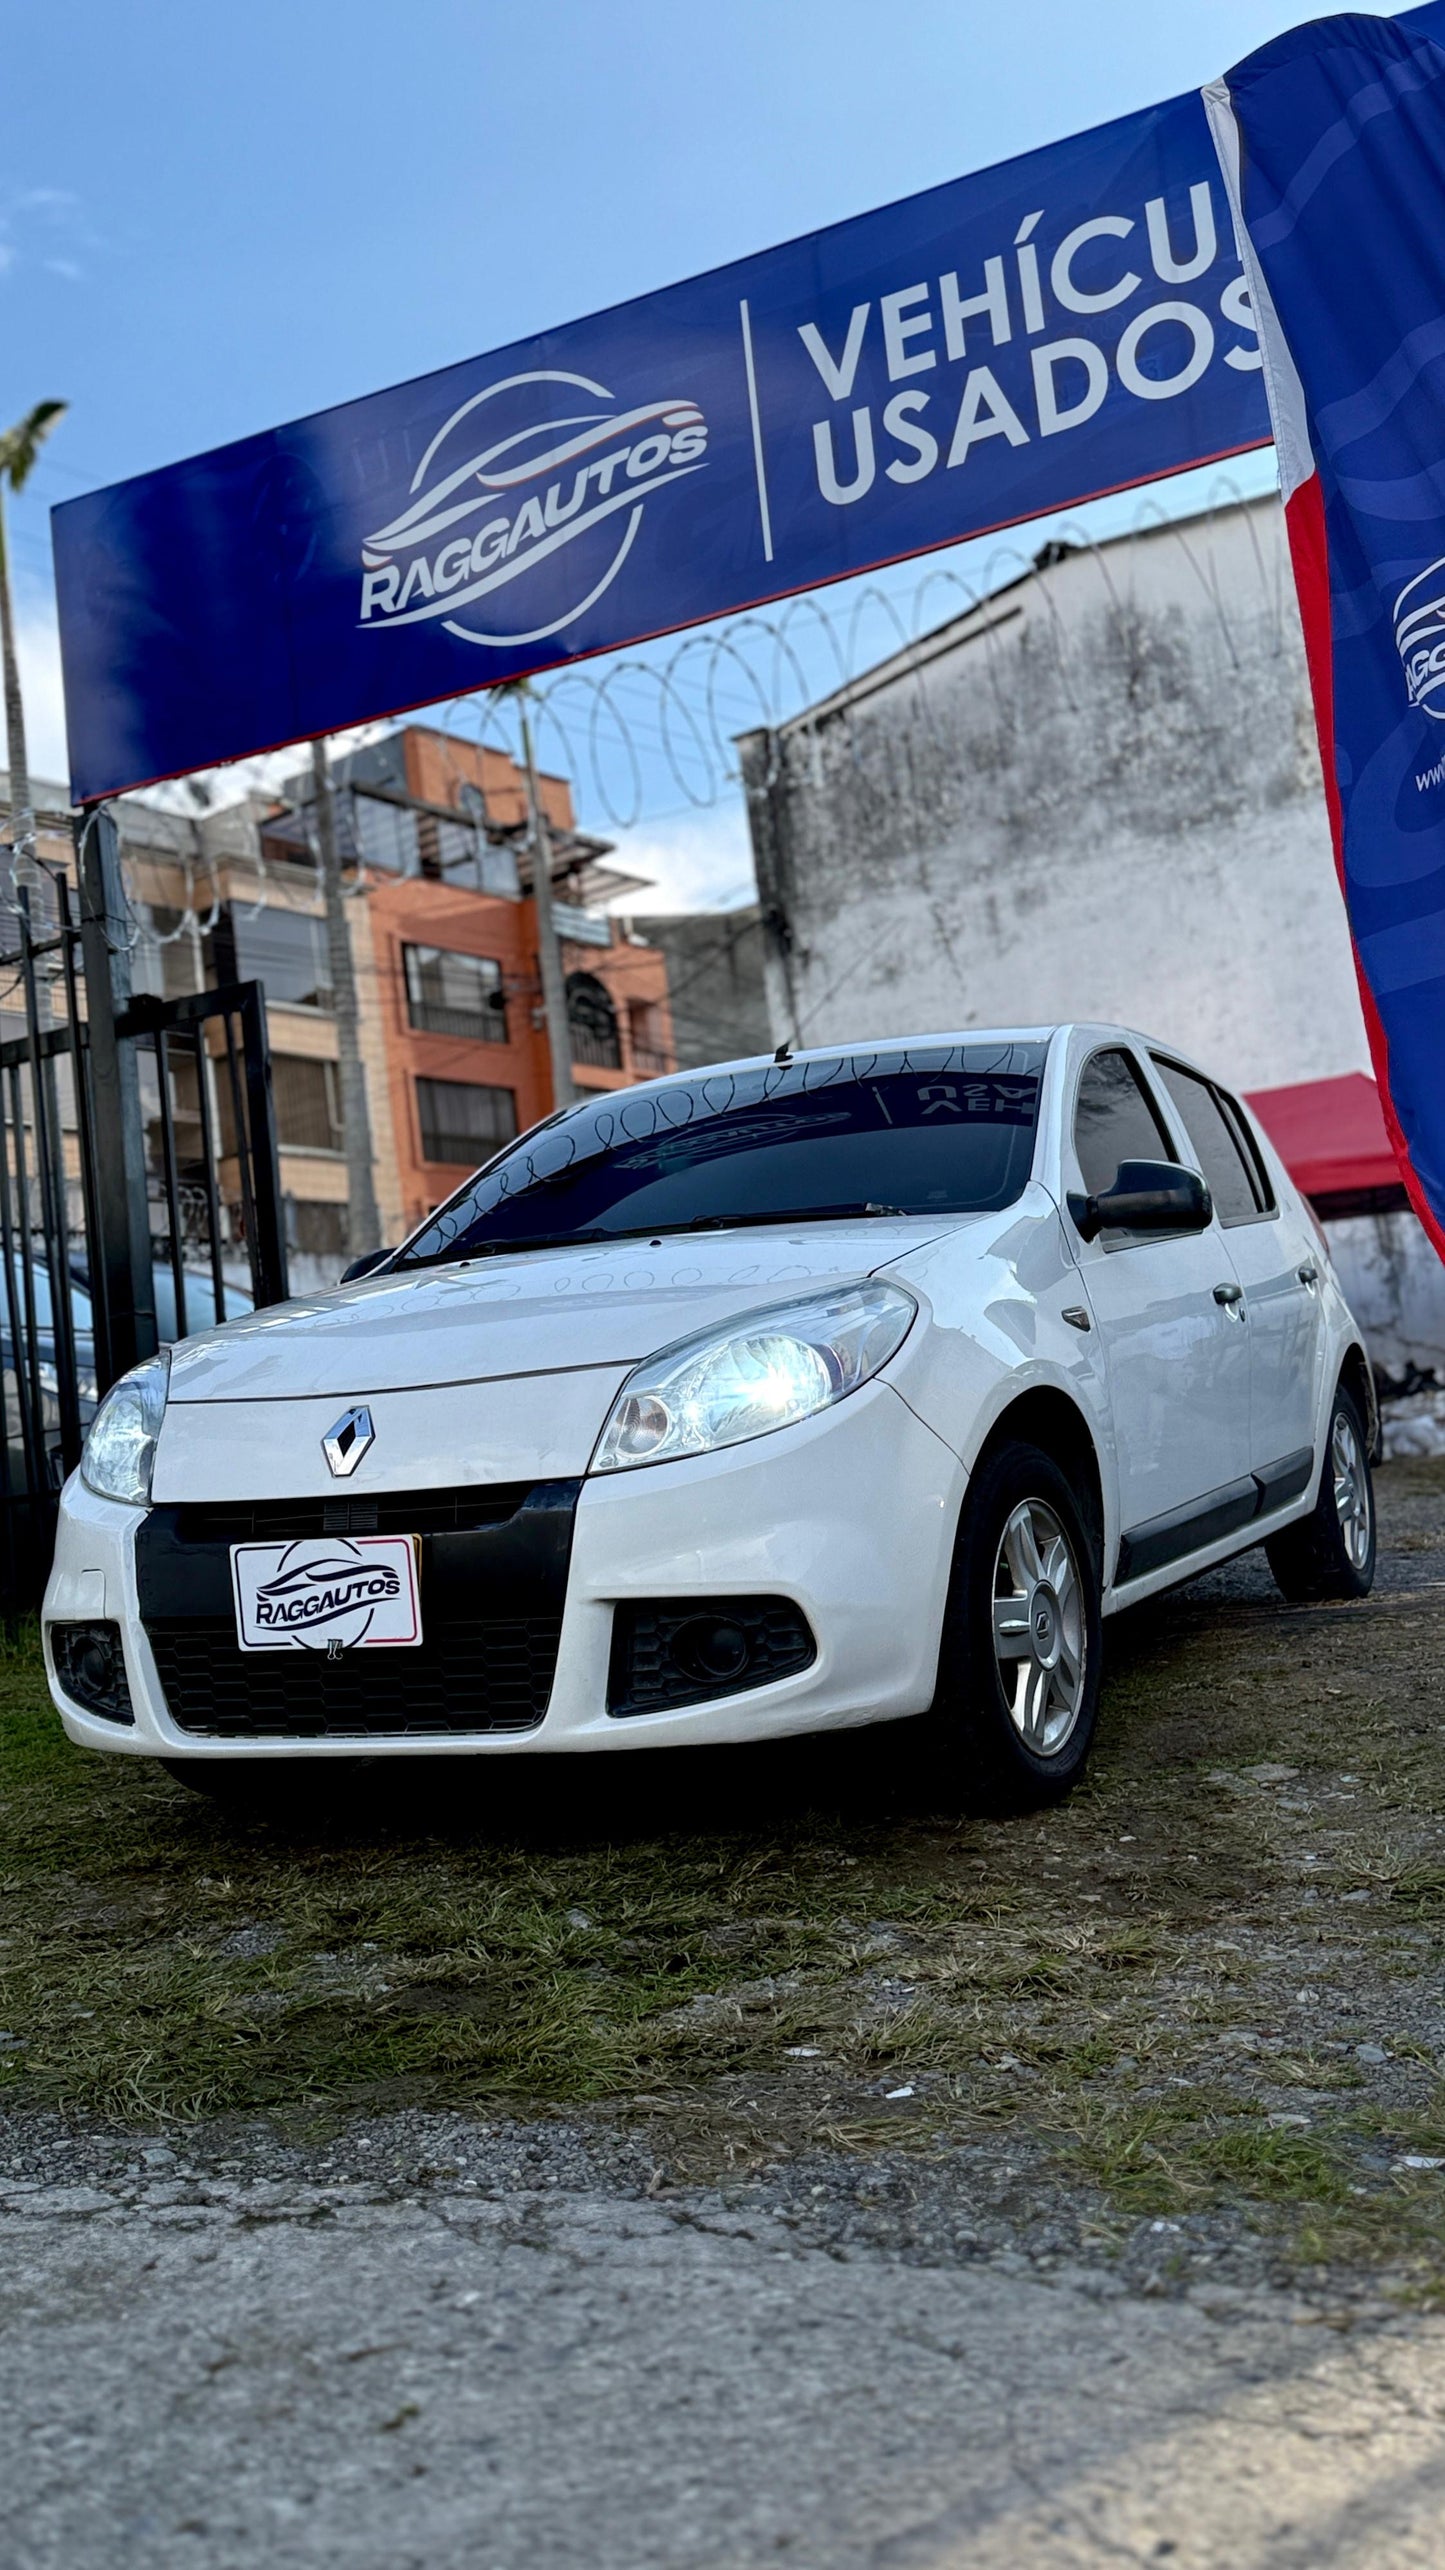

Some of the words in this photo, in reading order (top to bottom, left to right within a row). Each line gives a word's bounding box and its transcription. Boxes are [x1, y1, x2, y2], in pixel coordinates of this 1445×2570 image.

[798, 181, 1242, 401] VEHÍCU
[812, 275, 1263, 505] USADOS
[360, 426, 708, 620] RAGGAUTOS
[256, 1579, 400, 1624] RAGGAUTOS
